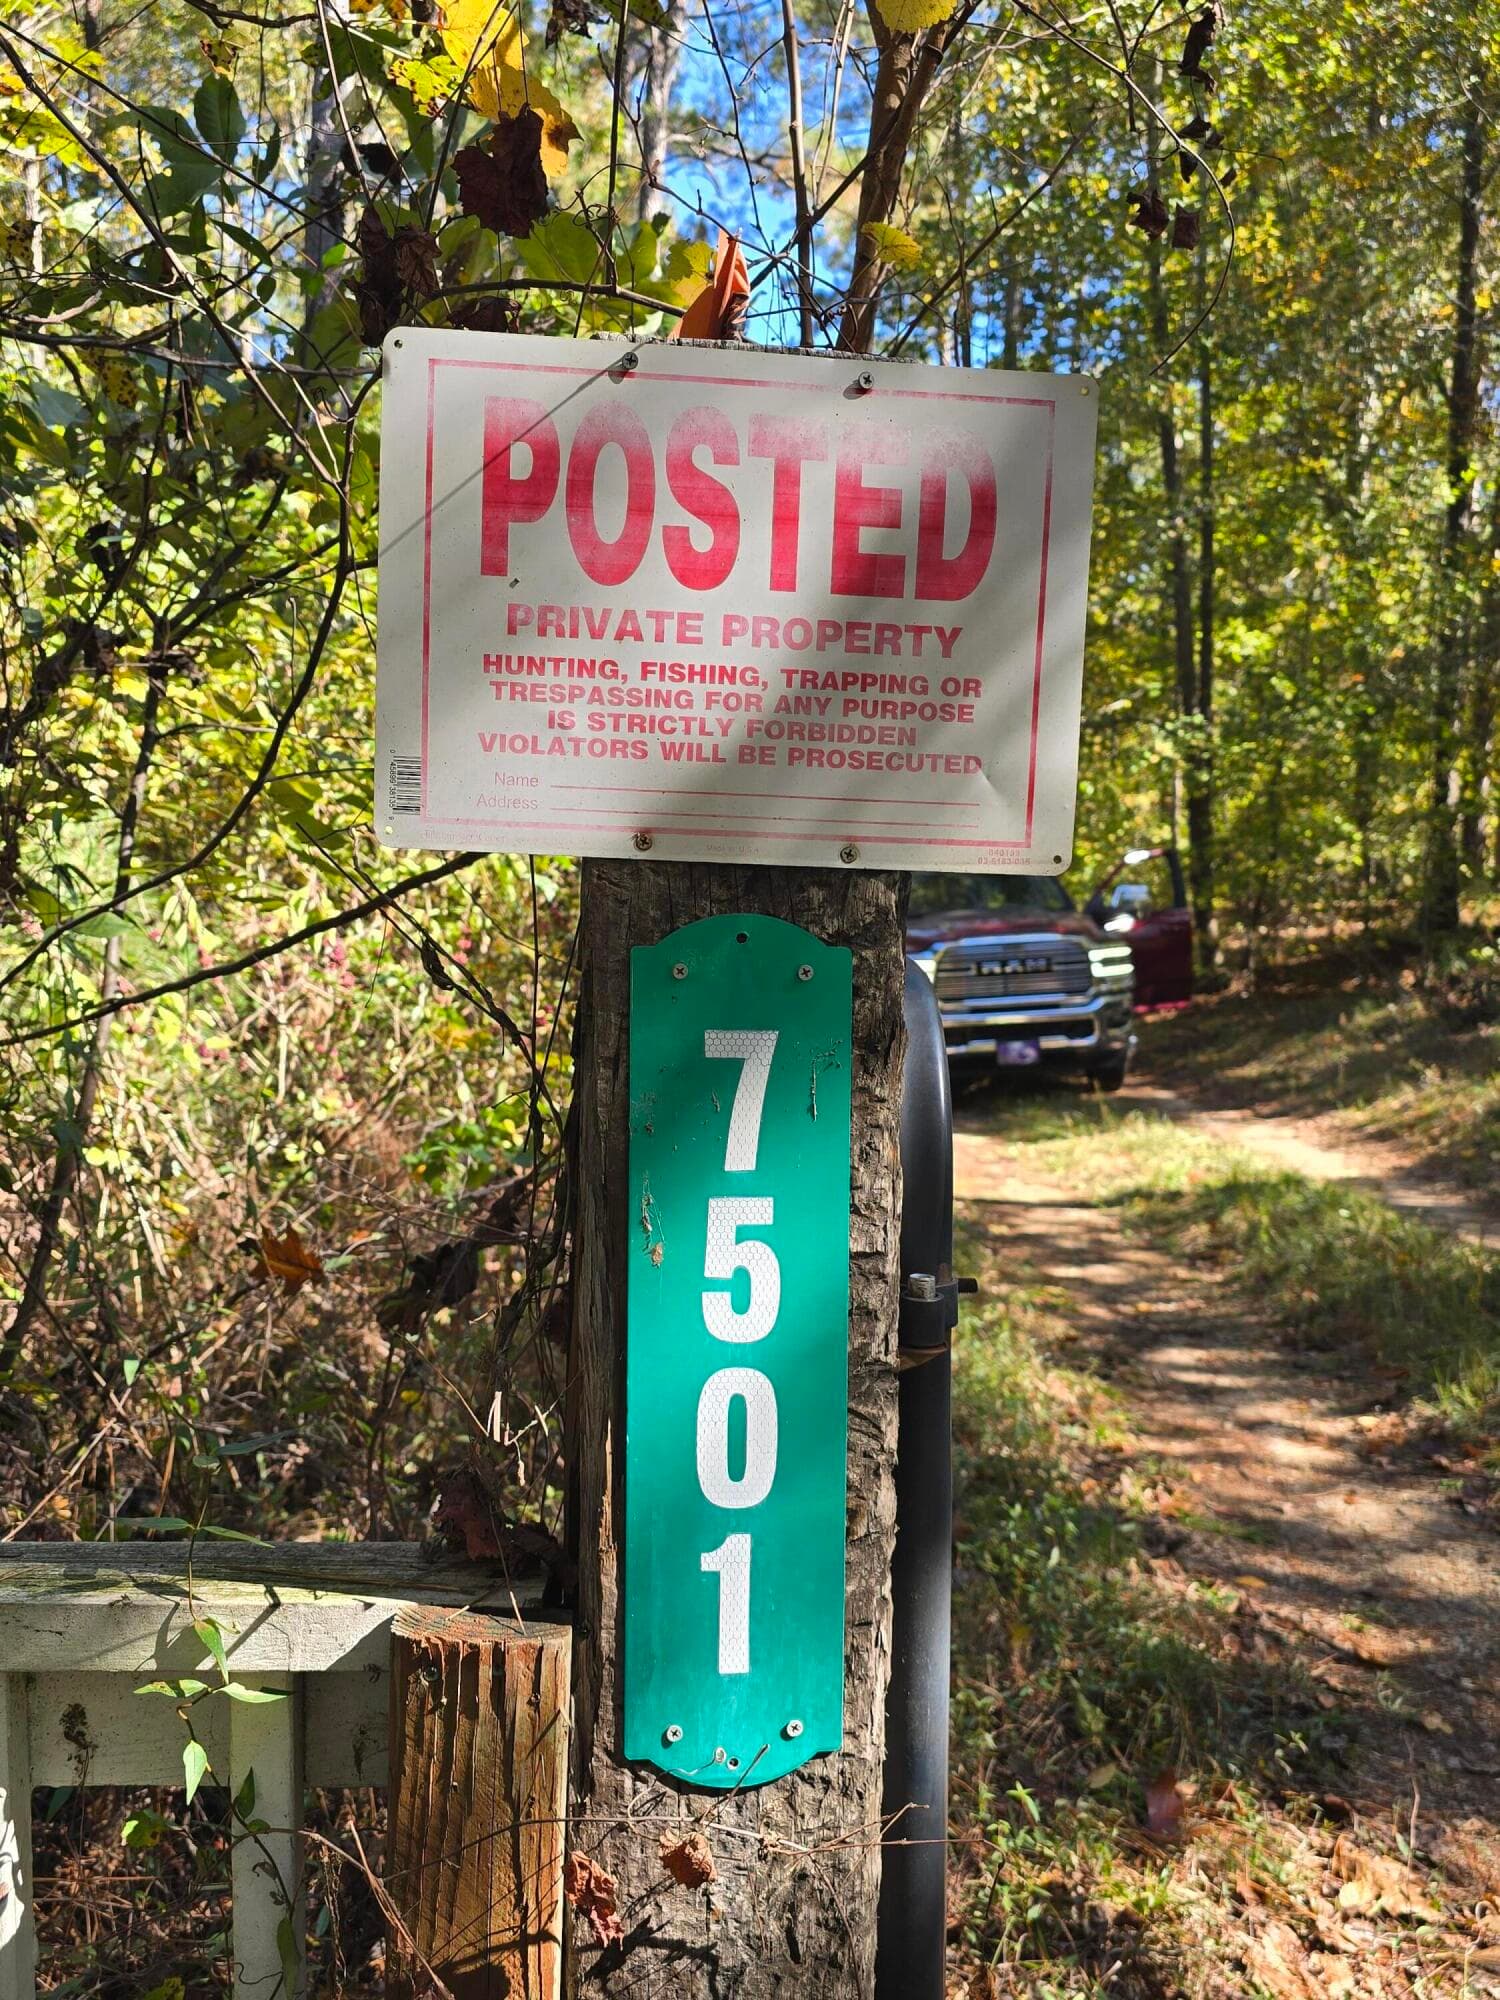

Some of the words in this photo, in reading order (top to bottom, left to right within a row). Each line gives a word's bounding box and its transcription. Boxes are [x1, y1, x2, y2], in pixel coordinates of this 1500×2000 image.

[481, 395, 998, 601] POSTED
[507, 602, 704, 645] PRIVATE
[722, 613, 964, 659] PROPERTY
[483, 653, 628, 685] HUNTING,
[640, 661, 769, 691] FISHING,
[780, 668, 929, 696] TRAPPING
[940, 676, 983, 698] OR
[489, 680, 694, 710] TRESPASSING
[705, 691, 763, 713] FOR
[774, 694, 832, 717] ANY
[842, 698, 975, 723] PURPOSE
[548, 709, 576, 731] IS
[587, 711, 733, 737] STRICTLY
[746, 719, 917, 746] FORBIDDEN
[478, 732, 649, 760] VIOLATORS
[660, 741, 727, 763] WILL
[737, 744, 777, 766] BE
[788, 747, 983, 775] PROSECUTED
[494, 771, 539, 788] Name
[476, 793, 539, 810] Address
[697, 1029, 781, 1675] 7501
